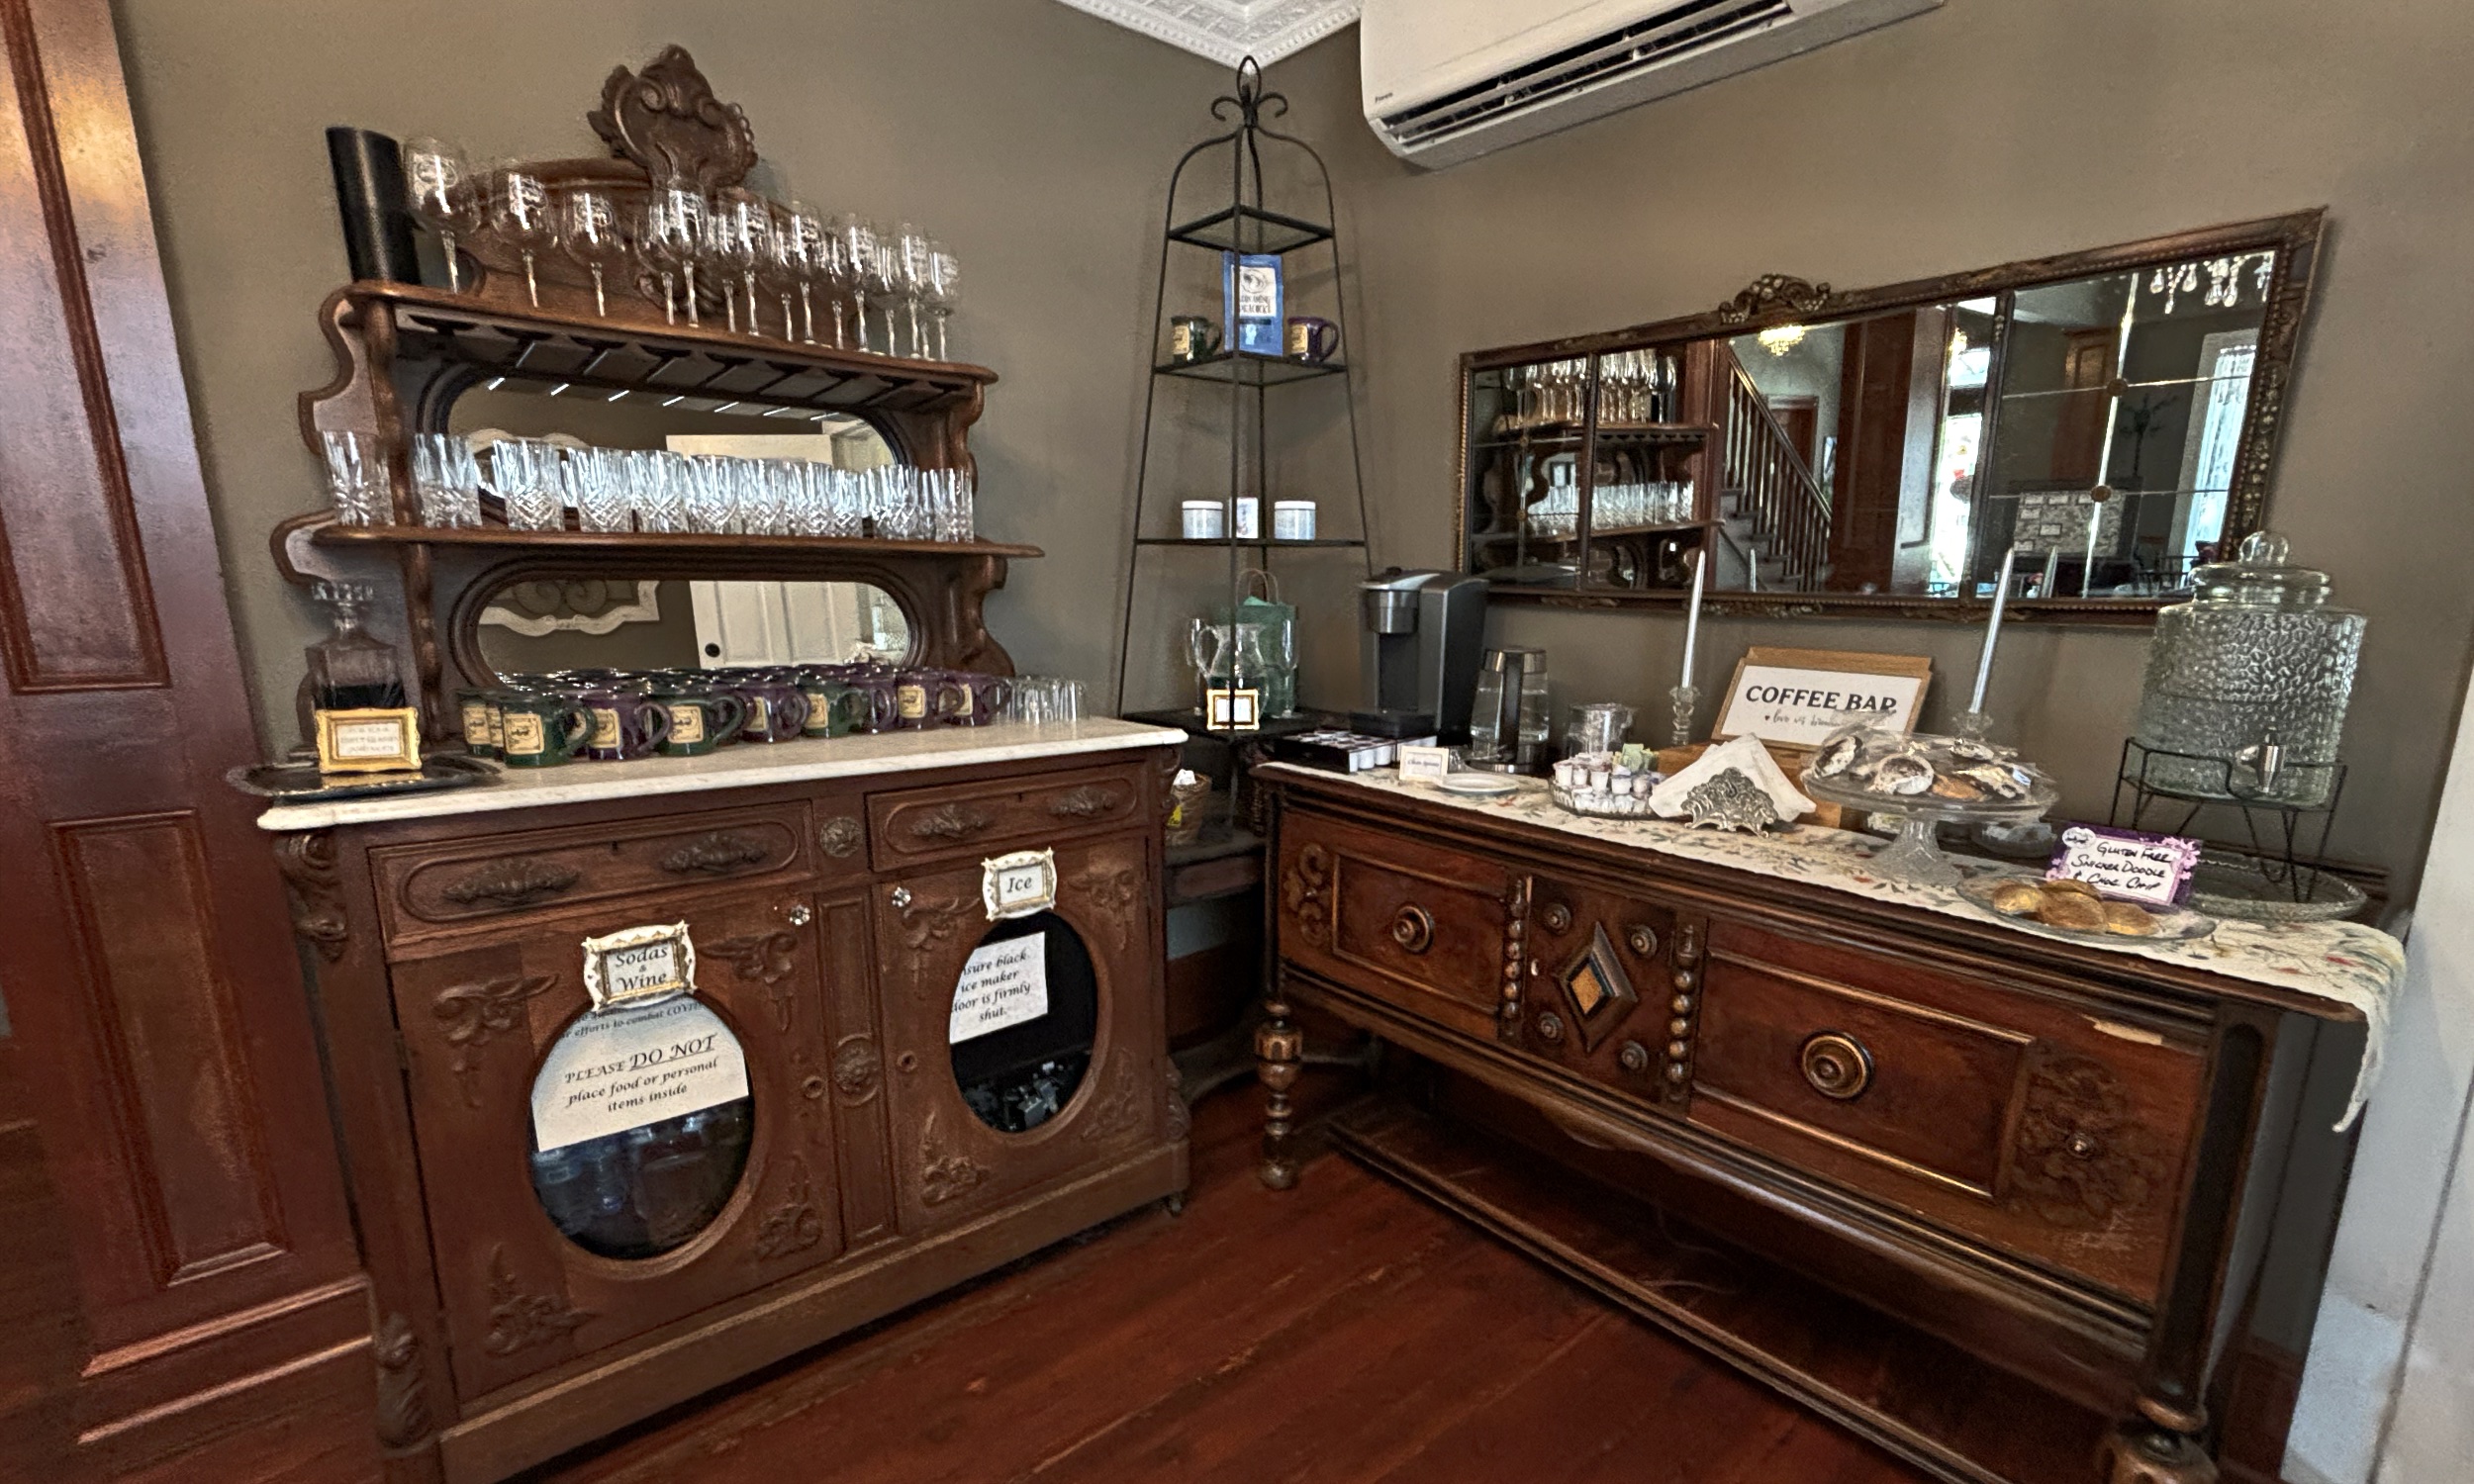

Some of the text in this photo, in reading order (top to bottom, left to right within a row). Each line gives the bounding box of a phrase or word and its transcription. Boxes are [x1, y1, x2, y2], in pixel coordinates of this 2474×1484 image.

[1746, 685, 1897, 713] COFFEE BAR
[2096, 841, 2139, 858] GLUTEN
[2071, 853, 2166, 878] SNICKER DOODLE
[1006, 877, 1032, 893] Ice
[615, 946, 669, 968] Sodas
[638, 964, 647, 973] &
[617, 972, 668, 991] Wine
[961, 970, 1019, 993] ice maker
[982, 992, 991, 1005] is
[992, 980, 1030, 1005] firmly
[979, 1006, 1007, 1023] shut.
[574, 1021, 610, 1037] efforts
[565, 1033, 717, 1083] PLEASE DO NOT
[564, 1057, 718, 1108] place food or personal
[608, 1082, 688, 1113] items inside
